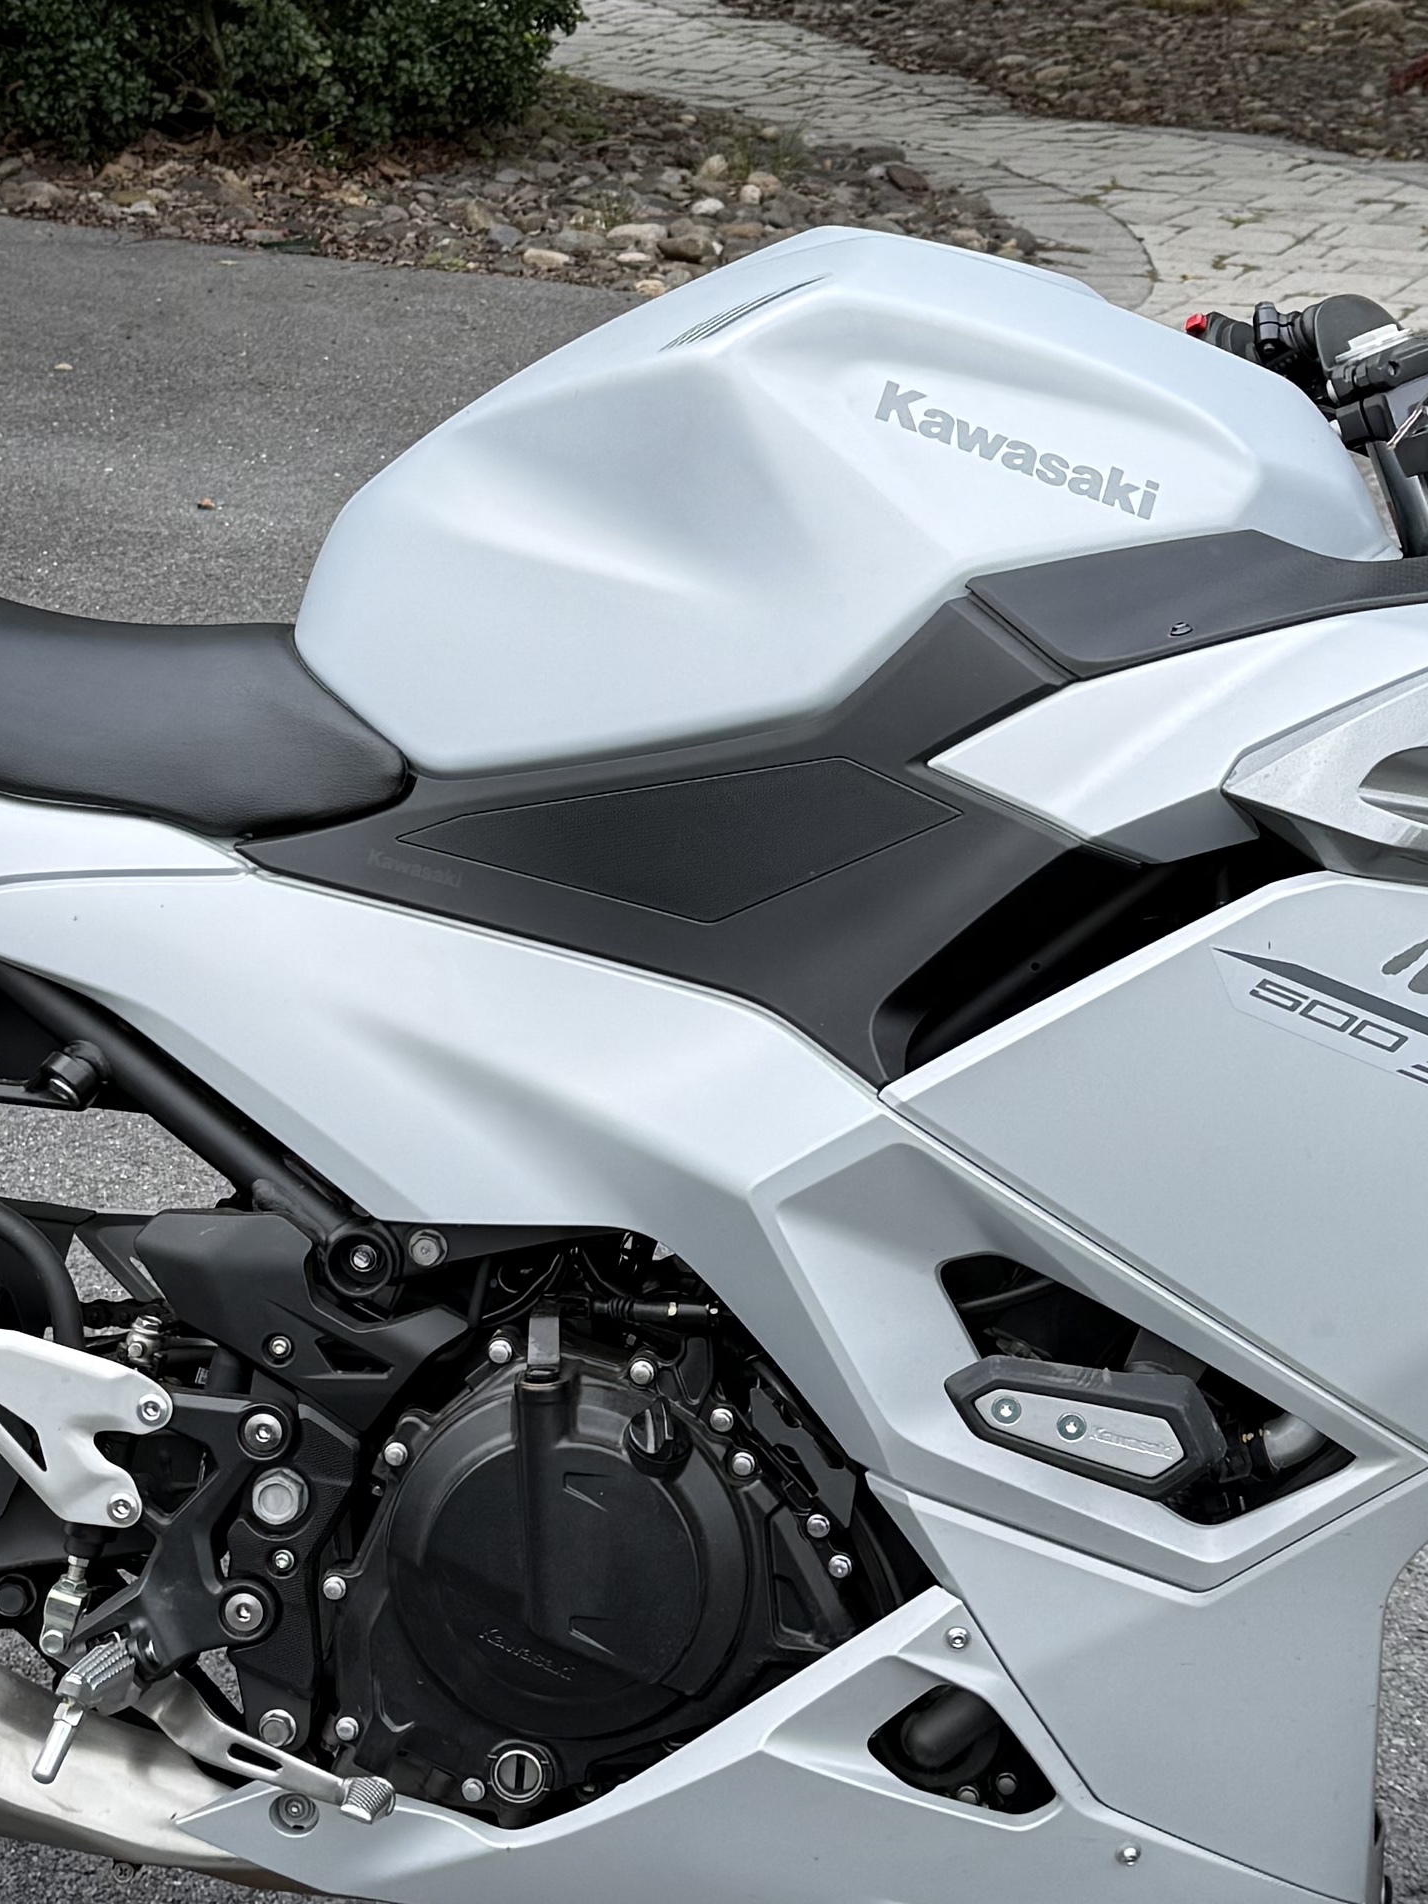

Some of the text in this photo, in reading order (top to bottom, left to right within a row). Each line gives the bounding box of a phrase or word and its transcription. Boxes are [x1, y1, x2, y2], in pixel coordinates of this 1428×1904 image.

[875, 380, 1160, 520] Kawasaki
[368, 848, 463, 889] Kawasaki
[1249, 978, 1409, 1053] 500
[1089, 1424, 1175, 1460] Kawasaki
